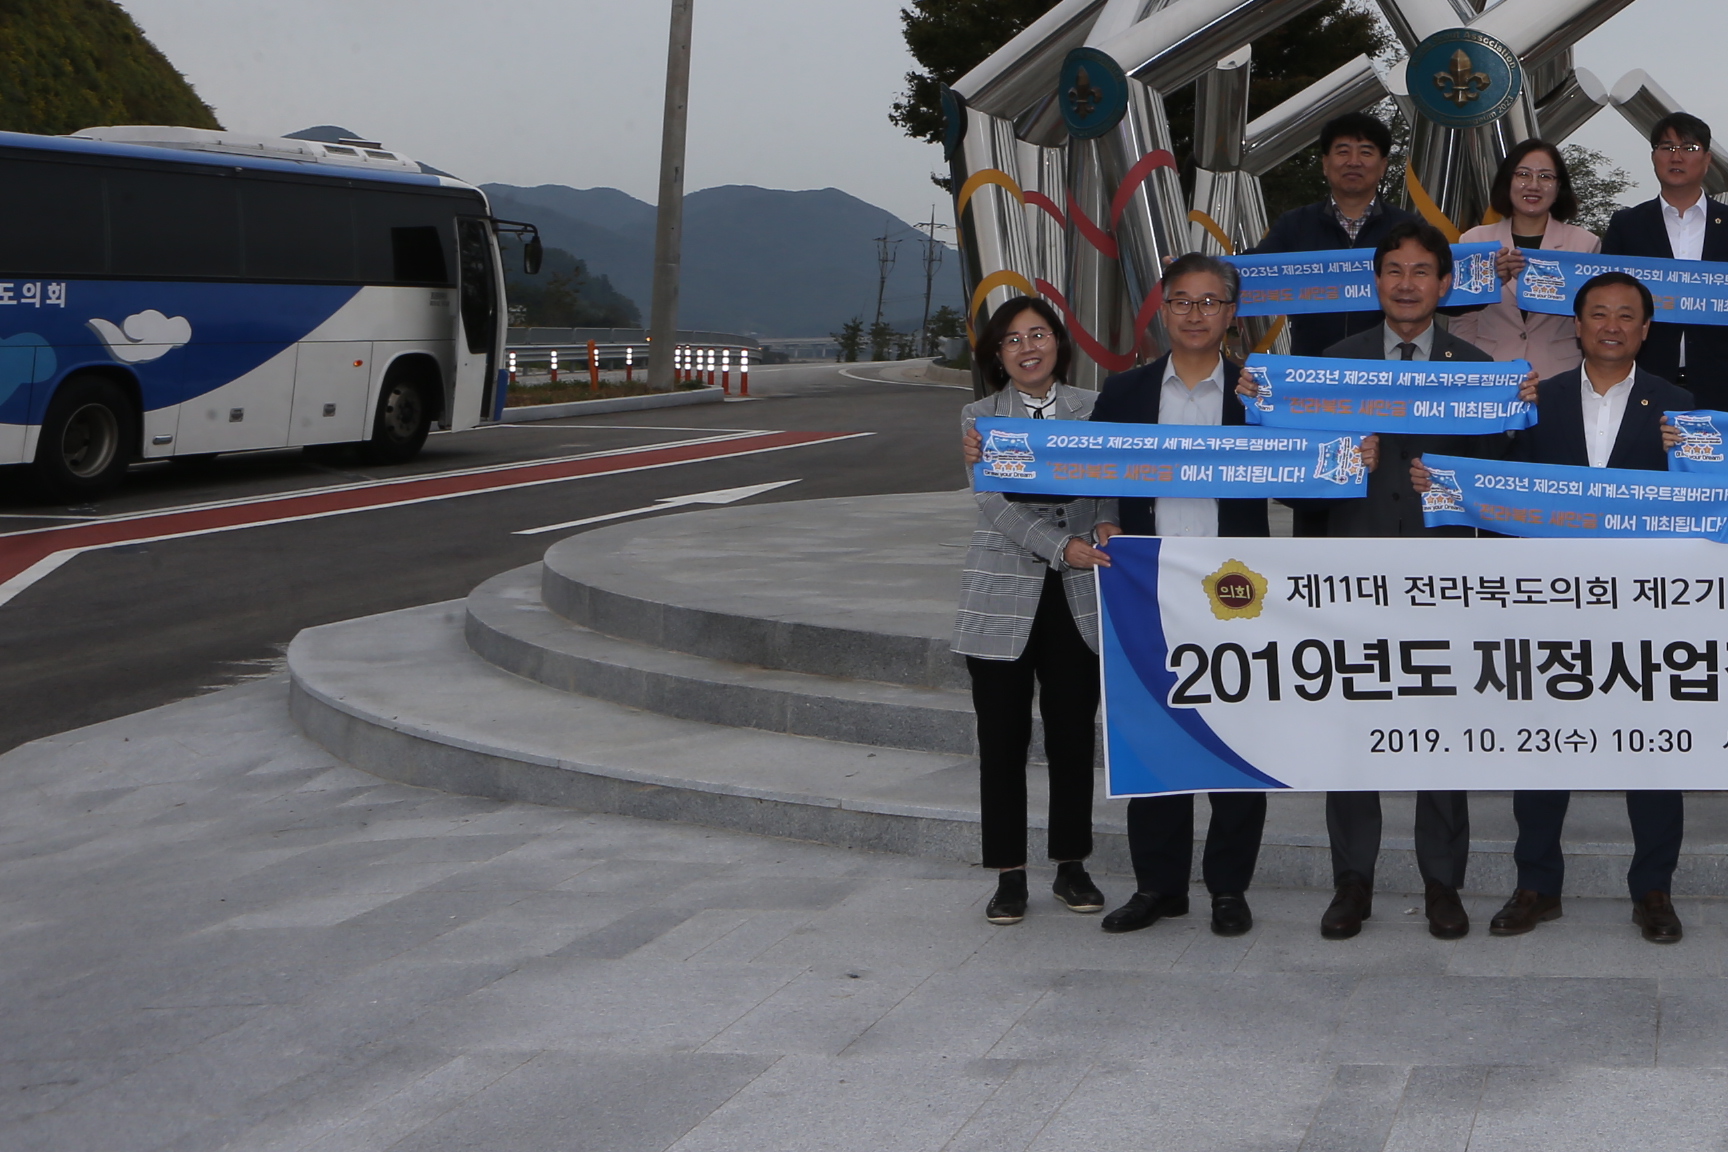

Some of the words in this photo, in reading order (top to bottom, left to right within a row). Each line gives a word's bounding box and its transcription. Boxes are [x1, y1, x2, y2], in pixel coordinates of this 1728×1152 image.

[1497, 95, 1514, 114] 2023
[1281, 263, 1324, 275] 제25회
[0, 282, 66, 308] 도의회
[1284, 368, 1340, 385] 2023년
[1342, 370, 1393, 386] 제25회
[1046, 434, 1104, 449] 2023년
[1106, 436, 1159, 450] 제25회
[1161, 437, 1309, 452] 세계스카우트잼버리가
[1218, 464, 1306, 484] 개최됩니다!
[1474, 473, 1529, 492] 2023년
[1533, 478, 1583, 496] 제25회
[1641, 515, 1728, 533] 개최됩니다!
[1218, 583, 1254, 601] 의회
[1286, 573, 1389, 609] 제11대
[1404, 575, 1618, 610] 전라북도의회
[1632, 576, 1725, 610] 제2기
[1169, 638, 1458, 706] 2019년도
[1369, 728, 1450, 753] 2019.
[1463, 728, 1505, 753] 10.
[1516, 728, 1598, 754] 23(수)
[1612, 728, 1692, 753] 10:30
